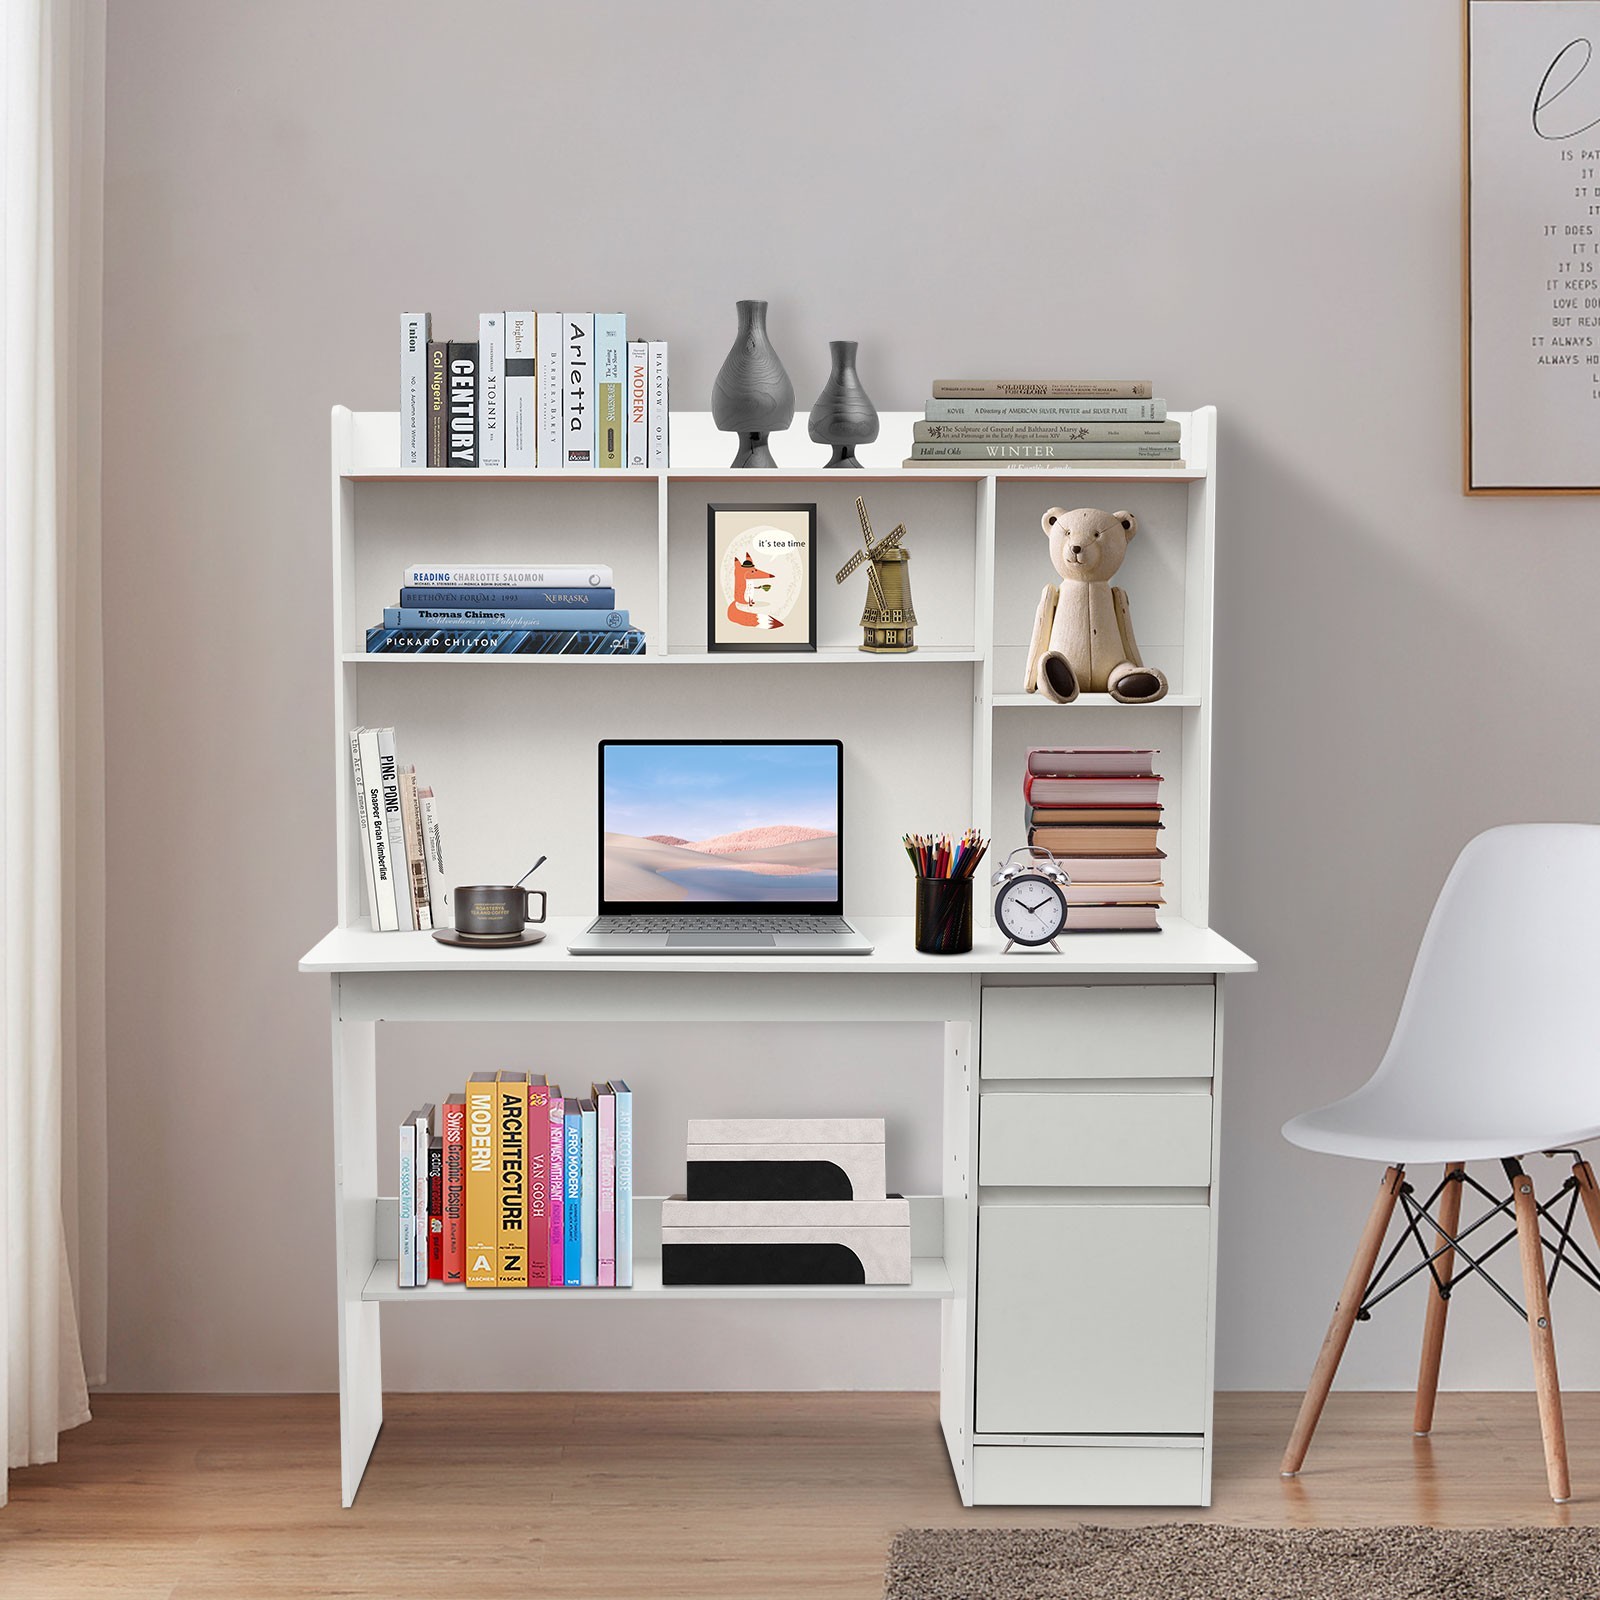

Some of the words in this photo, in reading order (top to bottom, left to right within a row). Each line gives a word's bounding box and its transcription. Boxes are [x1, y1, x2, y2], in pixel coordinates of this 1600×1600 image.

[1561, 151, 1573, 160] IS
[1582, 169, 1594, 179] IT
[1575, 188, 1587, 197] IT
[1589, 206, 1600, 215] IT
[1544, 226, 1557, 236] IT
[1565, 226, 1593, 236] DOES
[1573, 244, 1586, 253] IT
[1559, 262, 1571, 272] IT
[1580, 262, 1593, 272] IS
[1547, 280, 1558, 290] IT
[1565, 280, 1598, 290] KEEPS
[1553, 299, 1578, 309] LOVE
[1552, 317, 1572, 327] BUT
[409, 322, 418, 352] Union
[512, 320, 524, 353] Brightest
[1532, 337, 1544, 346] IT
[1551, 337, 1593, 346] ALWAYS
[433, 350, 443, 368] Col
[1537, 355, 1579, 364] ALWAYS
[570, 322, 586, 431] Arletta
[431, 371, 443, 411] Nigeria
[633, 366, 644, 423] MODERN
[451, 359, 475, 462] CENTURY
[487, 375, 497, 429] KINFOLK
[986, 446, 1055, 456] WINTER
[414, 573, 450, 581] READING
[453, 573, 499, 581] CHARLOTTE
[503, 573, 544, 581] SALOMON
[406, 593, 457, 601] BEETHOVEN
[460, 593, 490, 603] FORUM
[543, 593, 589, 603] NEBRASKA
[386, 638, 439, 646] PICKARD
[444, 638, 498, 646] CHILTON
[381, 755, 395, 781] PING
[356, 777, 363, 786] of
[370, 788, 380, 819] Snapper
[384, 785, 399, 813] PONG
[374, 821, 382, 840] Brian
[376, 842, 388, 880] Kimberling
[447, 1112, 463, 1142] Swiss
[620, 1111, 631, 1127] ART
[471, 1094, 491, 1172] MODERN
[551, 1127, 563, 1140] NEW
[568, 1127, 578, 1154] AFRO
[620, 1130, 631, 1157] DECO
[402, 1157, 410, 1173] one
[430, 1152, 442, 1177] acting
[445, 1144, 463, 1182] Graphic
[502, 1094, 523, 1230] ARCHITECTURE
[533, 1154, 544, 1178] VAN
[551, 1163, 563, 1180] WITH
[400, 1173, 410, 1196] space
[568, 1156, 579, 1198] MODERN
[620, 1160, 631, 1191] HOUSE
[401, 1197, 411, 1219] living
[445, 1185, 463, 1219] Design
[533, 1182, 545, 1217] GOGH
[472, 1255, 491, 1271] A
[504, 1256, 521, 1270] Z
